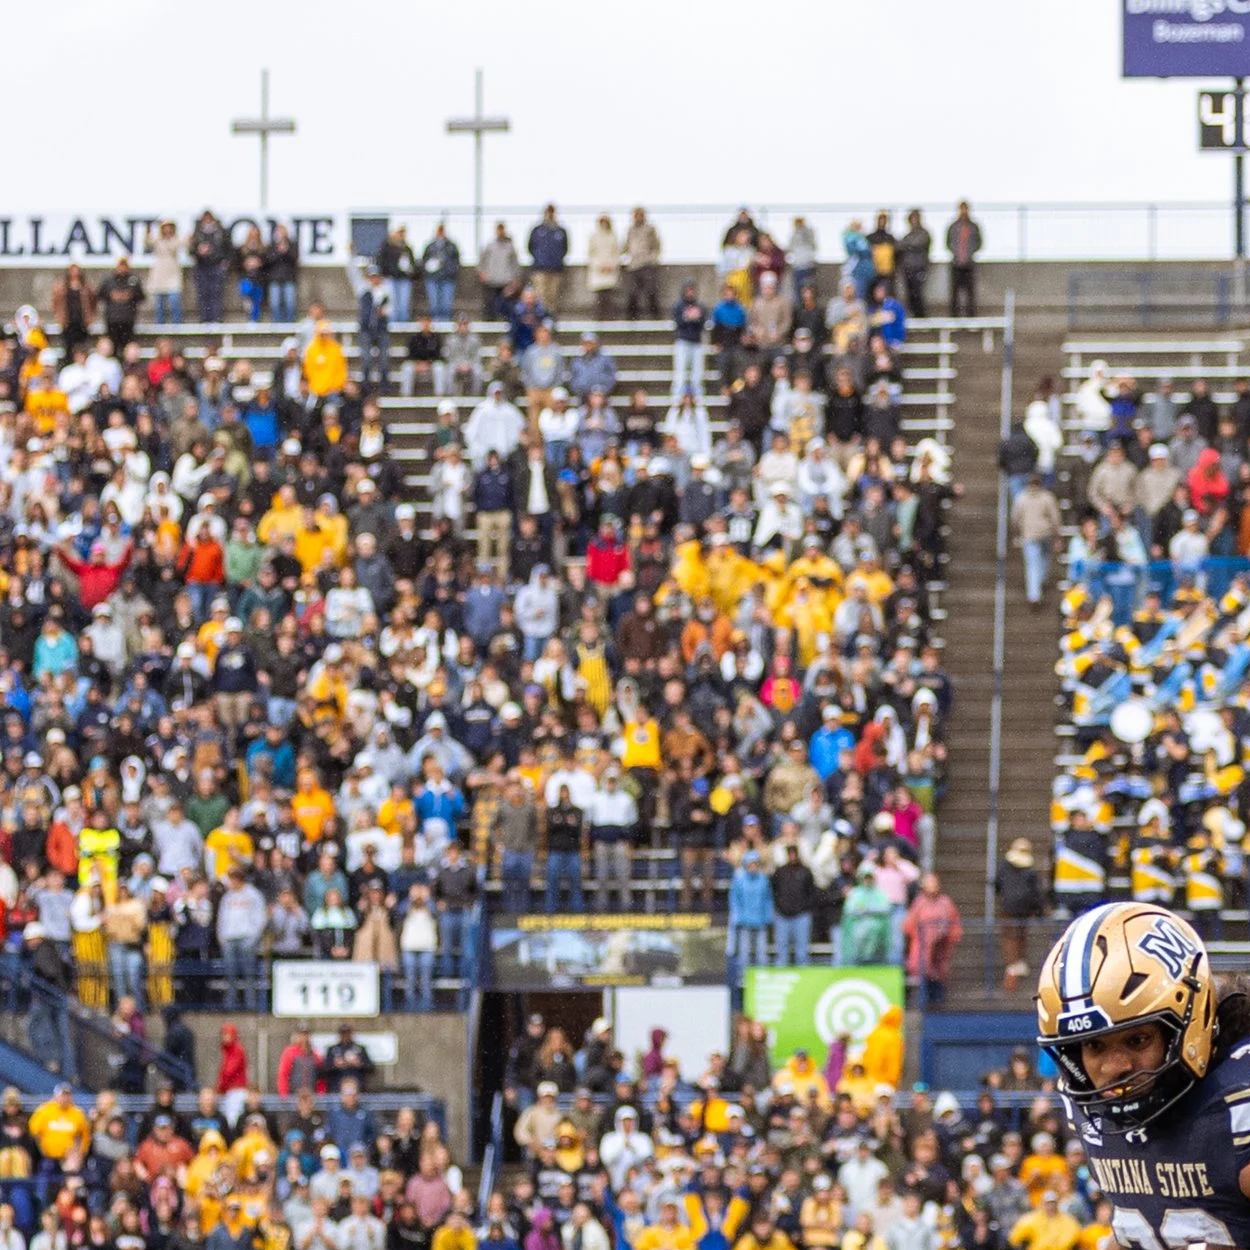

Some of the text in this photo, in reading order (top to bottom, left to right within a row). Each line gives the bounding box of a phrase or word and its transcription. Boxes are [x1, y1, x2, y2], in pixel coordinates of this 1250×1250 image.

[1153, 20, 1245, 42] Bozeman
[1136, 917, 1198, 980] M
[298, 982, 356, 1008] 119
[1067, 1015, 1093, 1032] 406
[1155, 1162, 1216, 1198] STATE
